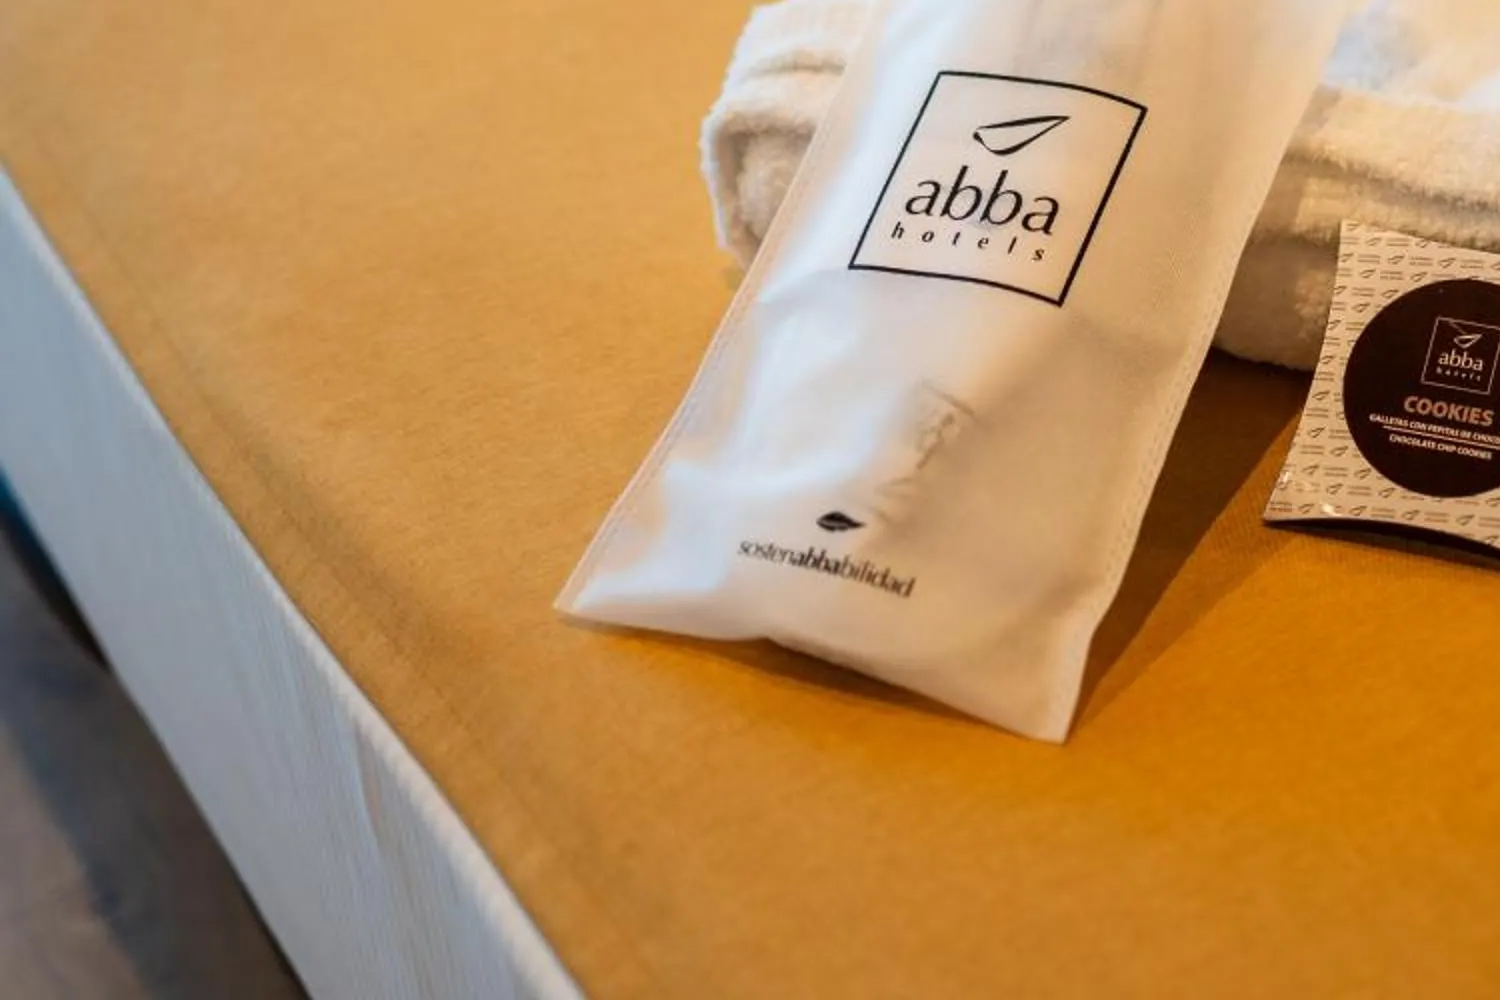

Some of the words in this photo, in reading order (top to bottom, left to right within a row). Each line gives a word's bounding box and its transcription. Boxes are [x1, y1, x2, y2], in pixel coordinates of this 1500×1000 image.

[904, 165, 1060, 236] abba
[890, 221, 1045, 262] hotels
[1438, 349, 1483, 371] abba
[1369, 413, 1409, 428] GALLETAS
[1409, 420, 1427, 431] CON
[1403, 395, 1495, 427] COOKIES
[1389, 433, 1436, 449] CHOCOLATE
[1437, 442, 1457, 453] CHIP
[1457, 446, 1493, 460] COOKIES
[737, 540, 917, 599] sostenabbabilidad
